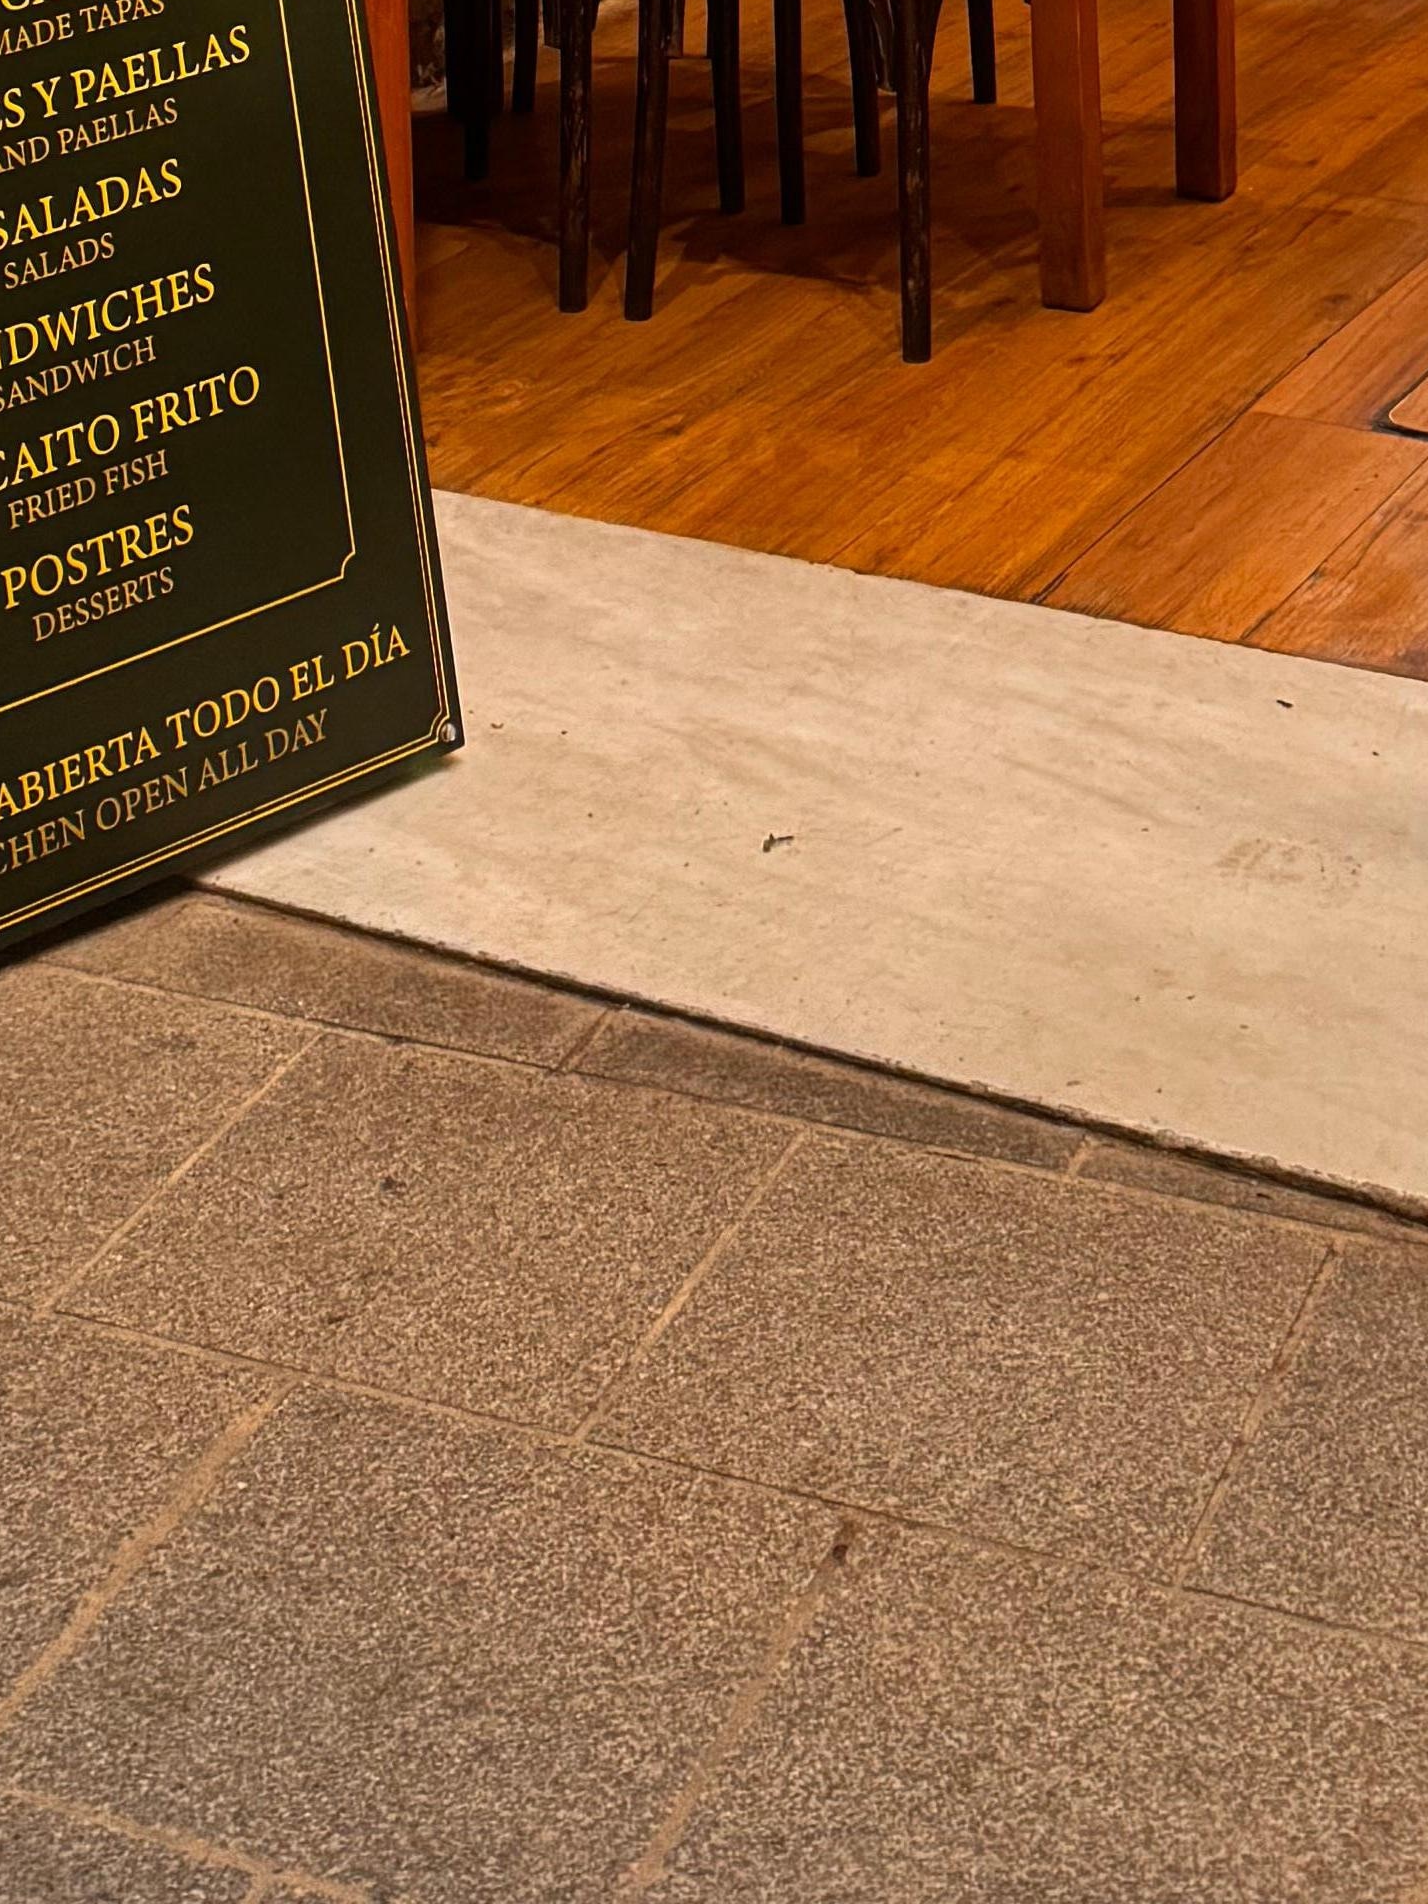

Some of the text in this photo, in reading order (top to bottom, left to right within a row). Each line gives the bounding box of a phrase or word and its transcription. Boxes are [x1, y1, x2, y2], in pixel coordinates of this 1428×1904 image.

[32, 77, 60, 117] Y
[71, 25, 249, 109] PAELLAS
[57, 98, 177, 154] PAELLAS
[5, 232, 114, 289] SALADS
[131, 366, 259, 442] FRITO
[8, 449, 168, 529] FRIED FISH
[1, 505, 193, 609] POSTRES
[33, 567, 173, 641] DESSERTS
[166, 677, 279, 748] TODO
[289, 655, 334, 700] EL
[342, 622, 412, 681] DÍA
[97, 767, 187, 830] OPEN
[199, 742, 258, 791] ALL
[265, 709, 327, 761] DAY
